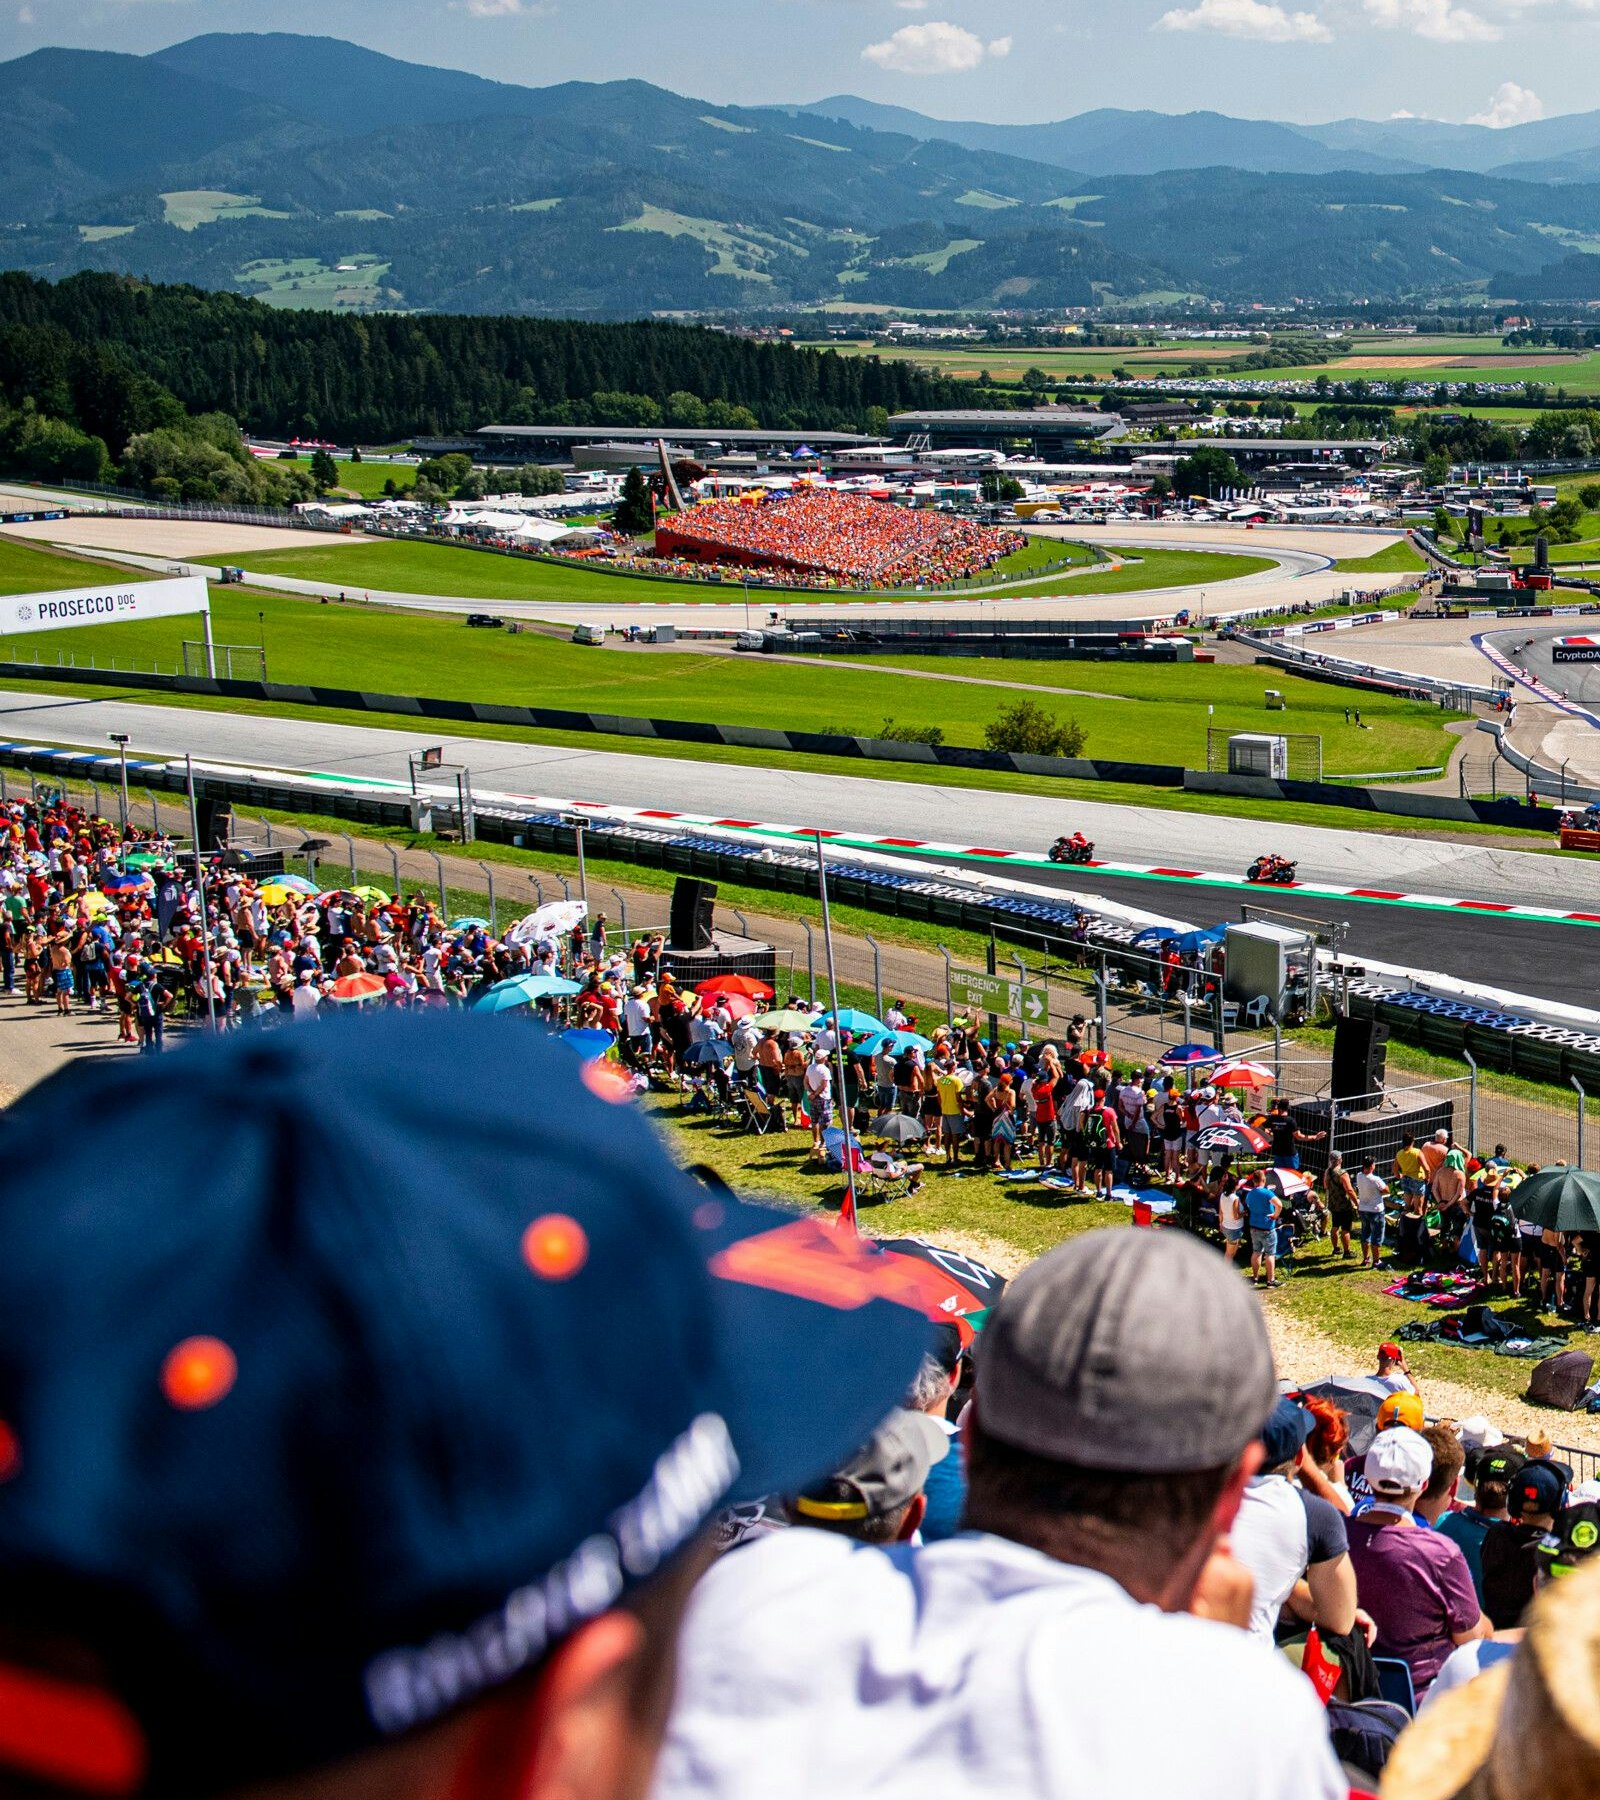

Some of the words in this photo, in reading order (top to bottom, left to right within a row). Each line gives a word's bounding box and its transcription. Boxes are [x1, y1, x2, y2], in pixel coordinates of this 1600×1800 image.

[38, 596, 115, 620] PROSECCO
[117, 593, 136, 606] DOC
[950, 971, 1000, 994] EMERGENCY
[966, 989, 983, 1006] EXIT
